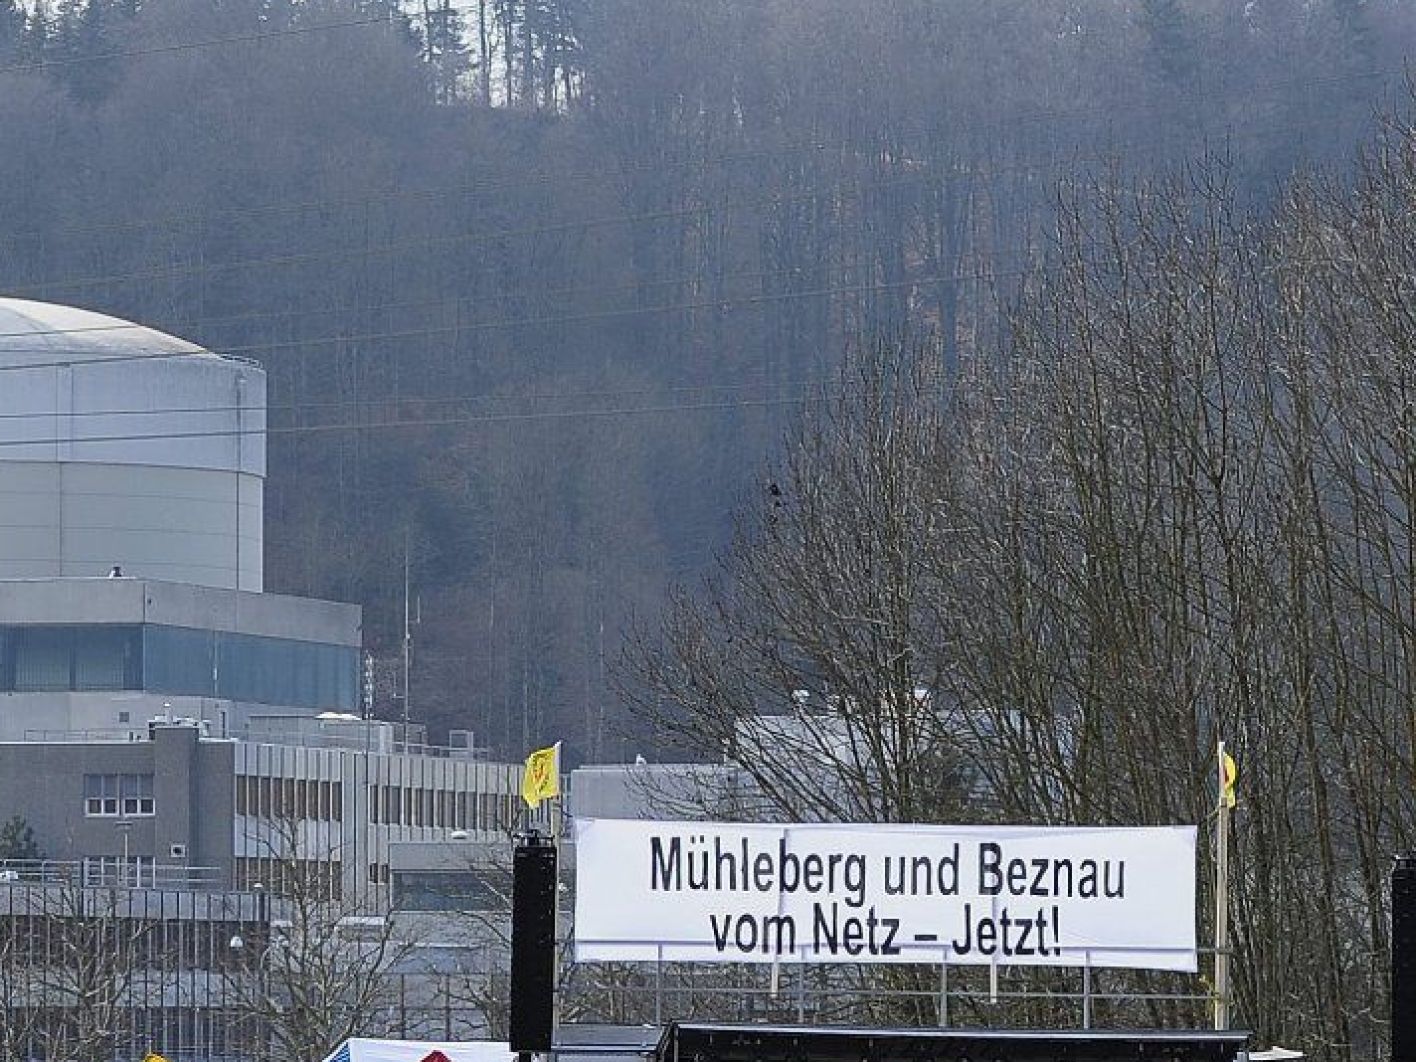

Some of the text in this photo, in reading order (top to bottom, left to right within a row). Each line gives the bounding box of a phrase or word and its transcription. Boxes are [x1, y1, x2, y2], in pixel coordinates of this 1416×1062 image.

[650, 836, 1125, 907] Mühleberg und Beznau
[710, 911, 796, 954] vom
[813, 902, 902, 956] Netz
[952, 902, 1062, 957] Jetzt!
